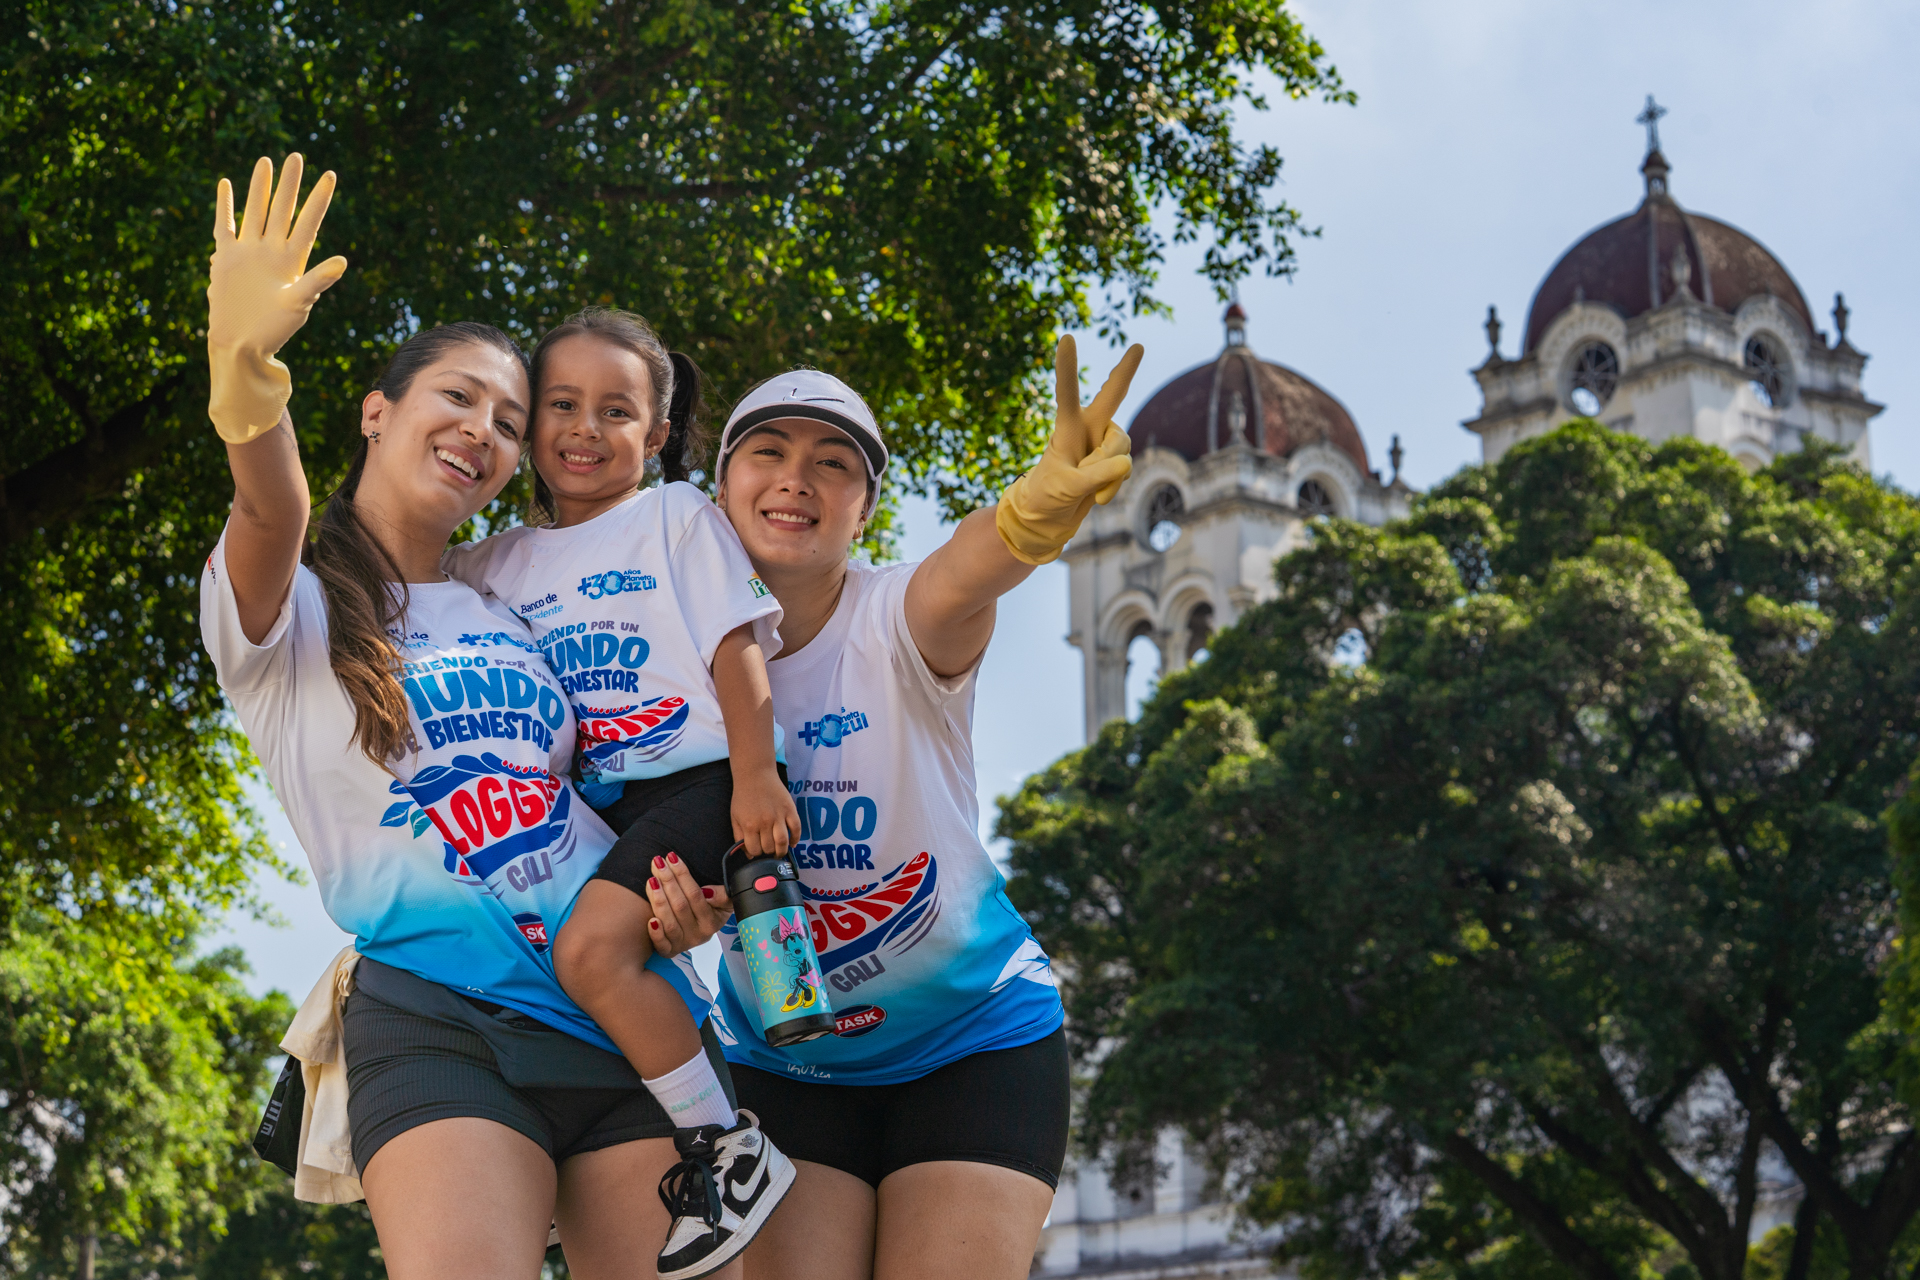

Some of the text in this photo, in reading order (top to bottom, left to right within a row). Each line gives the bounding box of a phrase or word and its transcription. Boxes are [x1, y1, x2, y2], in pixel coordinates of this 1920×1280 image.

[622, 577, 657, 592] azul
[521, 593, 558, 615] Banco de
[590, 620, 615, 631] POR
[620, 622, 640, 633] UN
[543, 633, 650, 677] UNDO
[494, 659, 528, 672] POR
[532, 668, 551, 687] UN
[559, 669, 639, 697] ENESTAR
[842, 712, 869, 737] zul
[804, 780, 834, 793] POR
[836, 780, 858, 793] UN
[793, 843, 875, 871] ESTAR
[829, 953, 886, 993] CALI
[836, 1011, 878, 1031] TASK
